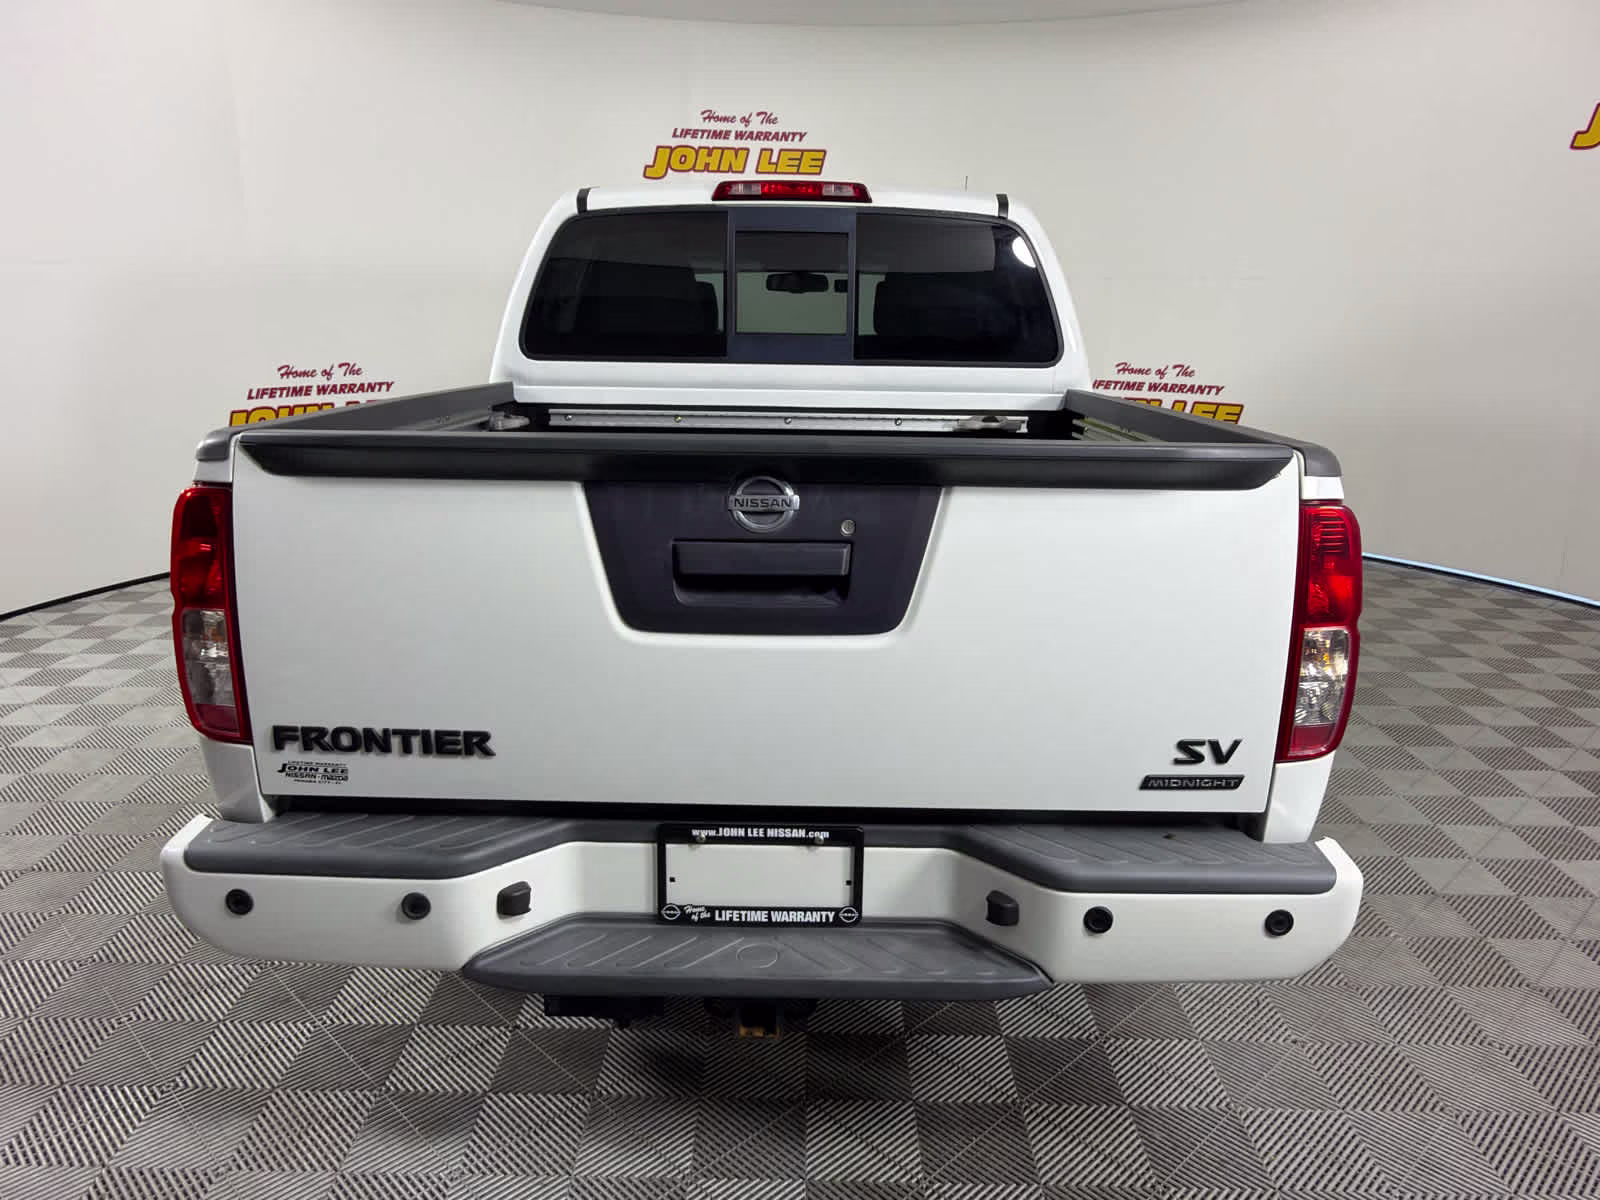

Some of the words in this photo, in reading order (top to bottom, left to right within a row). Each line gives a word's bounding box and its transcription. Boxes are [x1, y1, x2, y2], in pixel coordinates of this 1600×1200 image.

[700, 109, 736, 124] Home
[740, 112, 752, 127] of
[756, 112, 778, 125] The
[672, 128, 732, 140] LIFETIME
[734, 131, 808, 142] WARRANTY
[643, 145, 750, 179] JOHN
[755, 149, 826, 175] LEE
[277, 365, 318, 379] Home
[321, 364, 334, 380] of
[338, 362, 363, 376] The
[1115, 362, 1151, 376] Home
[1155, 365, 1168, 380] of
[1173, 364, 1196, 377] The
[247, 385, 313, 400] LIFETIME
[316, 381, 394, 395] WARRANTY
[1092, 379, 1146, 391] IFETIME
[1148, 381, 1225, 396] WARRANTY
[734, 498, 792, 508] NISSAN
[272, 725, 496, 757] FRONTIER
[1172, 739, 1242, 765] SV
[277, 763, 319, 773] JOHN
[1148, 779, 1239, 787] MIDNIGHT
[747, 828, 765, 838] LEE
[715, 910, 769, 922] LIFETIME
[771, 911, 835, 923] WARRANTY
